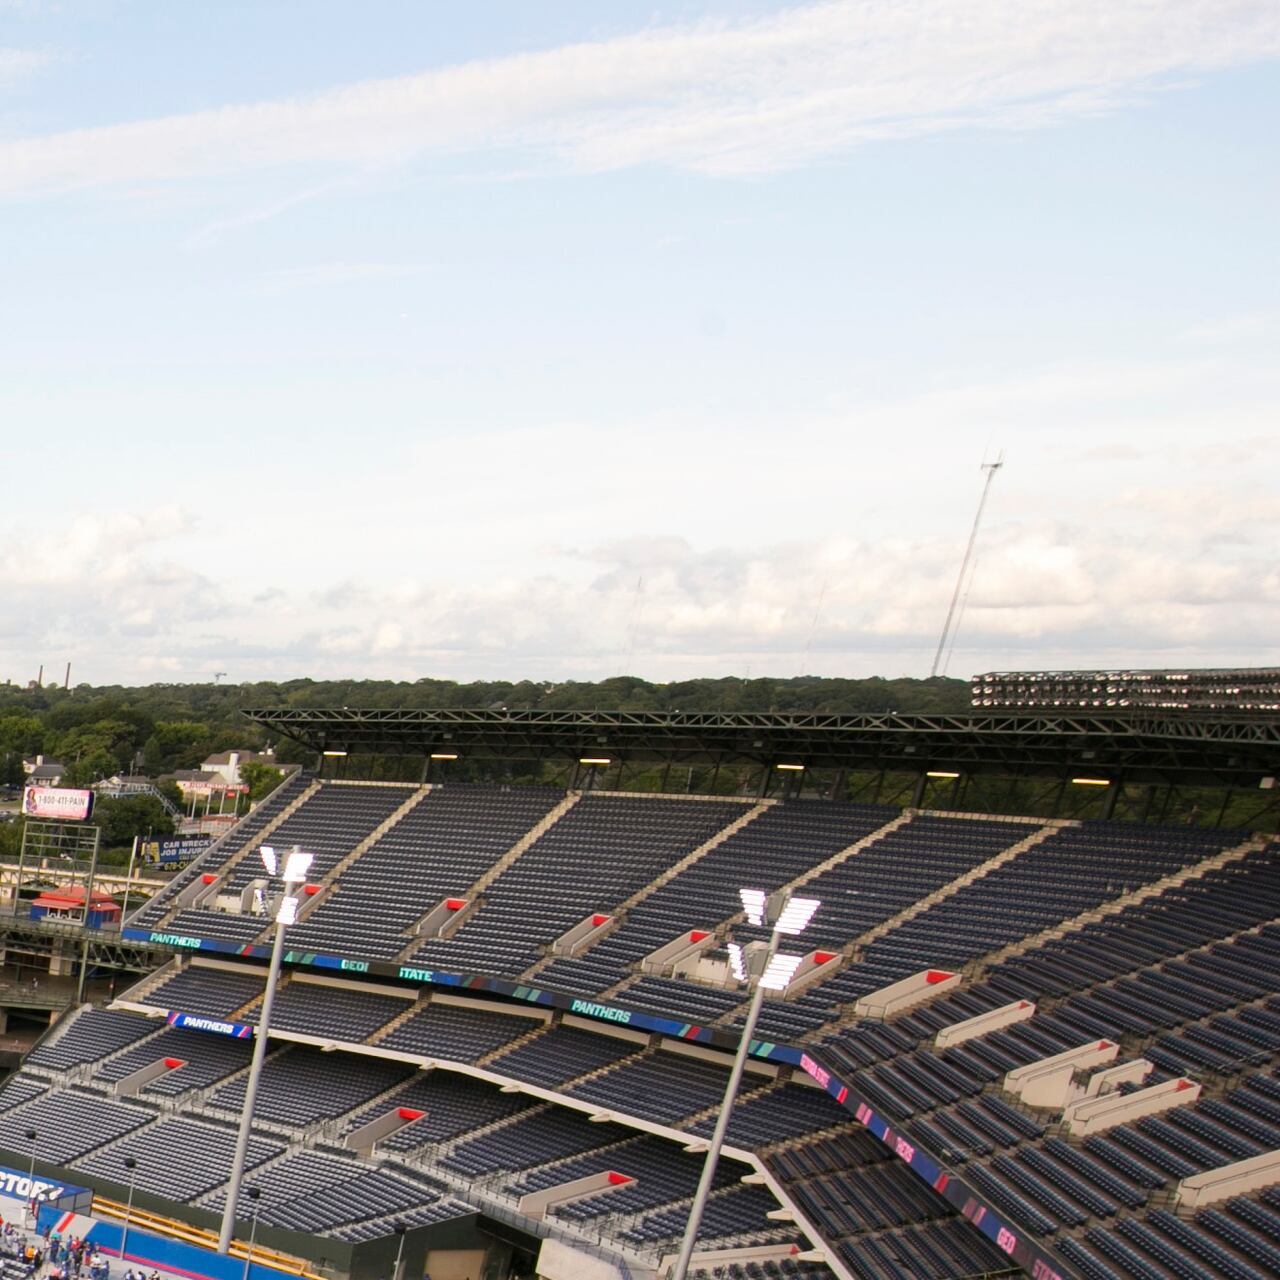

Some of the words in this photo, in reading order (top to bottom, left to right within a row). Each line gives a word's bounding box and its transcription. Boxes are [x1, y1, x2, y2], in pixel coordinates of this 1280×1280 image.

[38, 795, 86, 806] 1-800-411-PAIN
[163, 840, 180, 849] CAR
[160, 849, 178, 857] JOB
[150, 932, 202, 948] PANTHERS
[571, 999, 632, 1023] PANTHERS
[183, 1015, 234, 1034] PANTHERS
